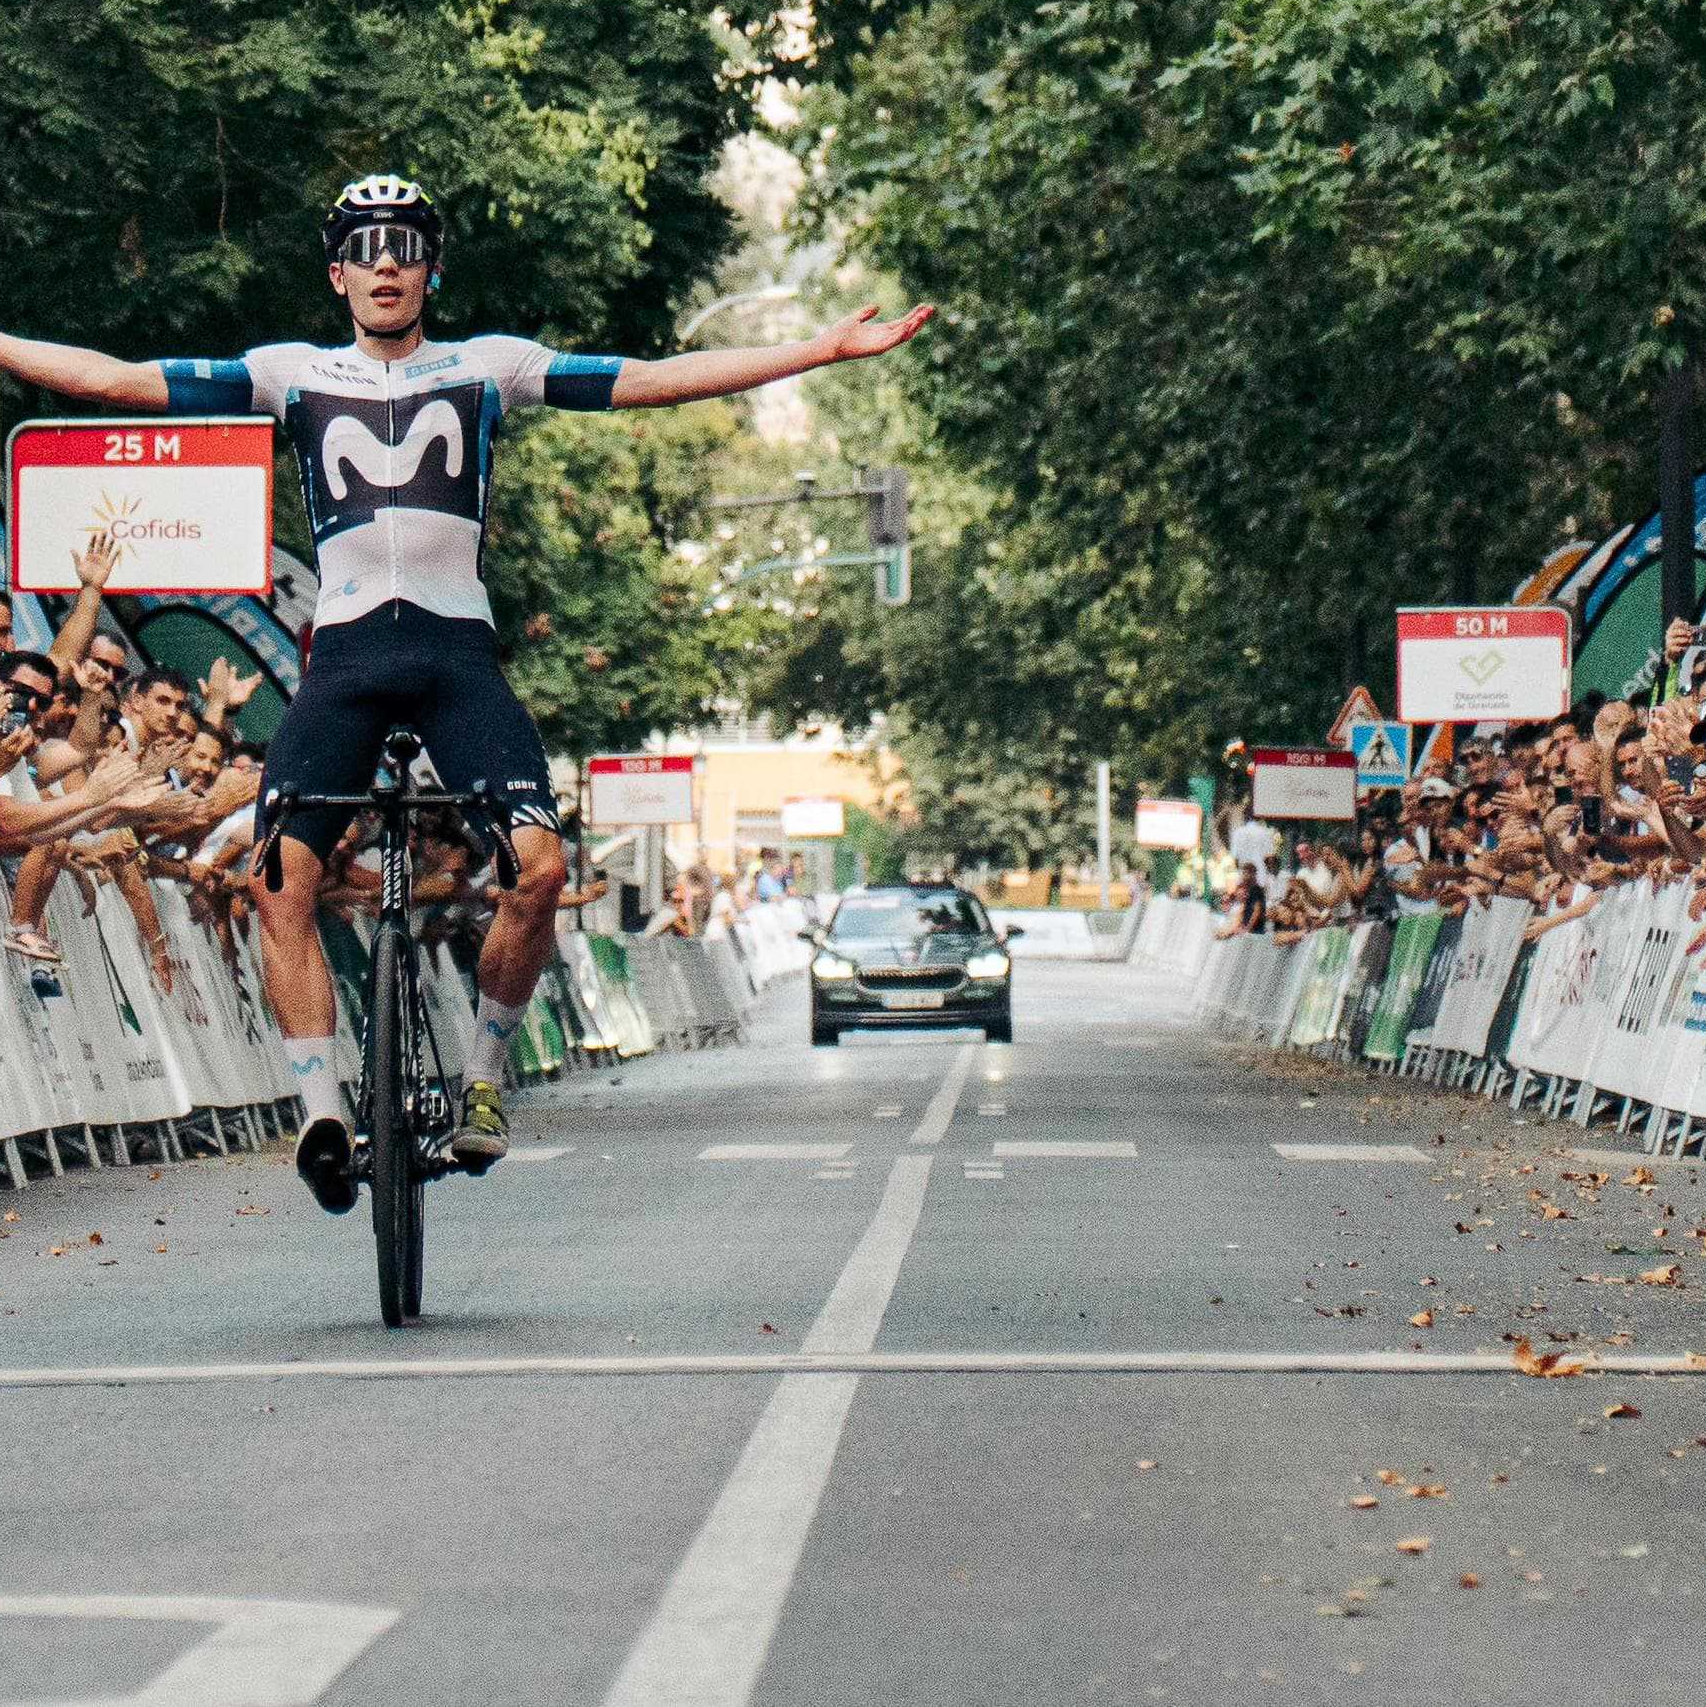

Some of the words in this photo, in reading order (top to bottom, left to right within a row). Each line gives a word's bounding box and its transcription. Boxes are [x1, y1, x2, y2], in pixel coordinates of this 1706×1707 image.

[311, 364, 378, 386] CANYON
[103, 434, 144, 462] 25
[153, 433, 182, 462] M
[109, 518, 202, 540] Cofidis
[1454, 616, 1485, 636] 50
[1489, 615, 1509, 635] M
